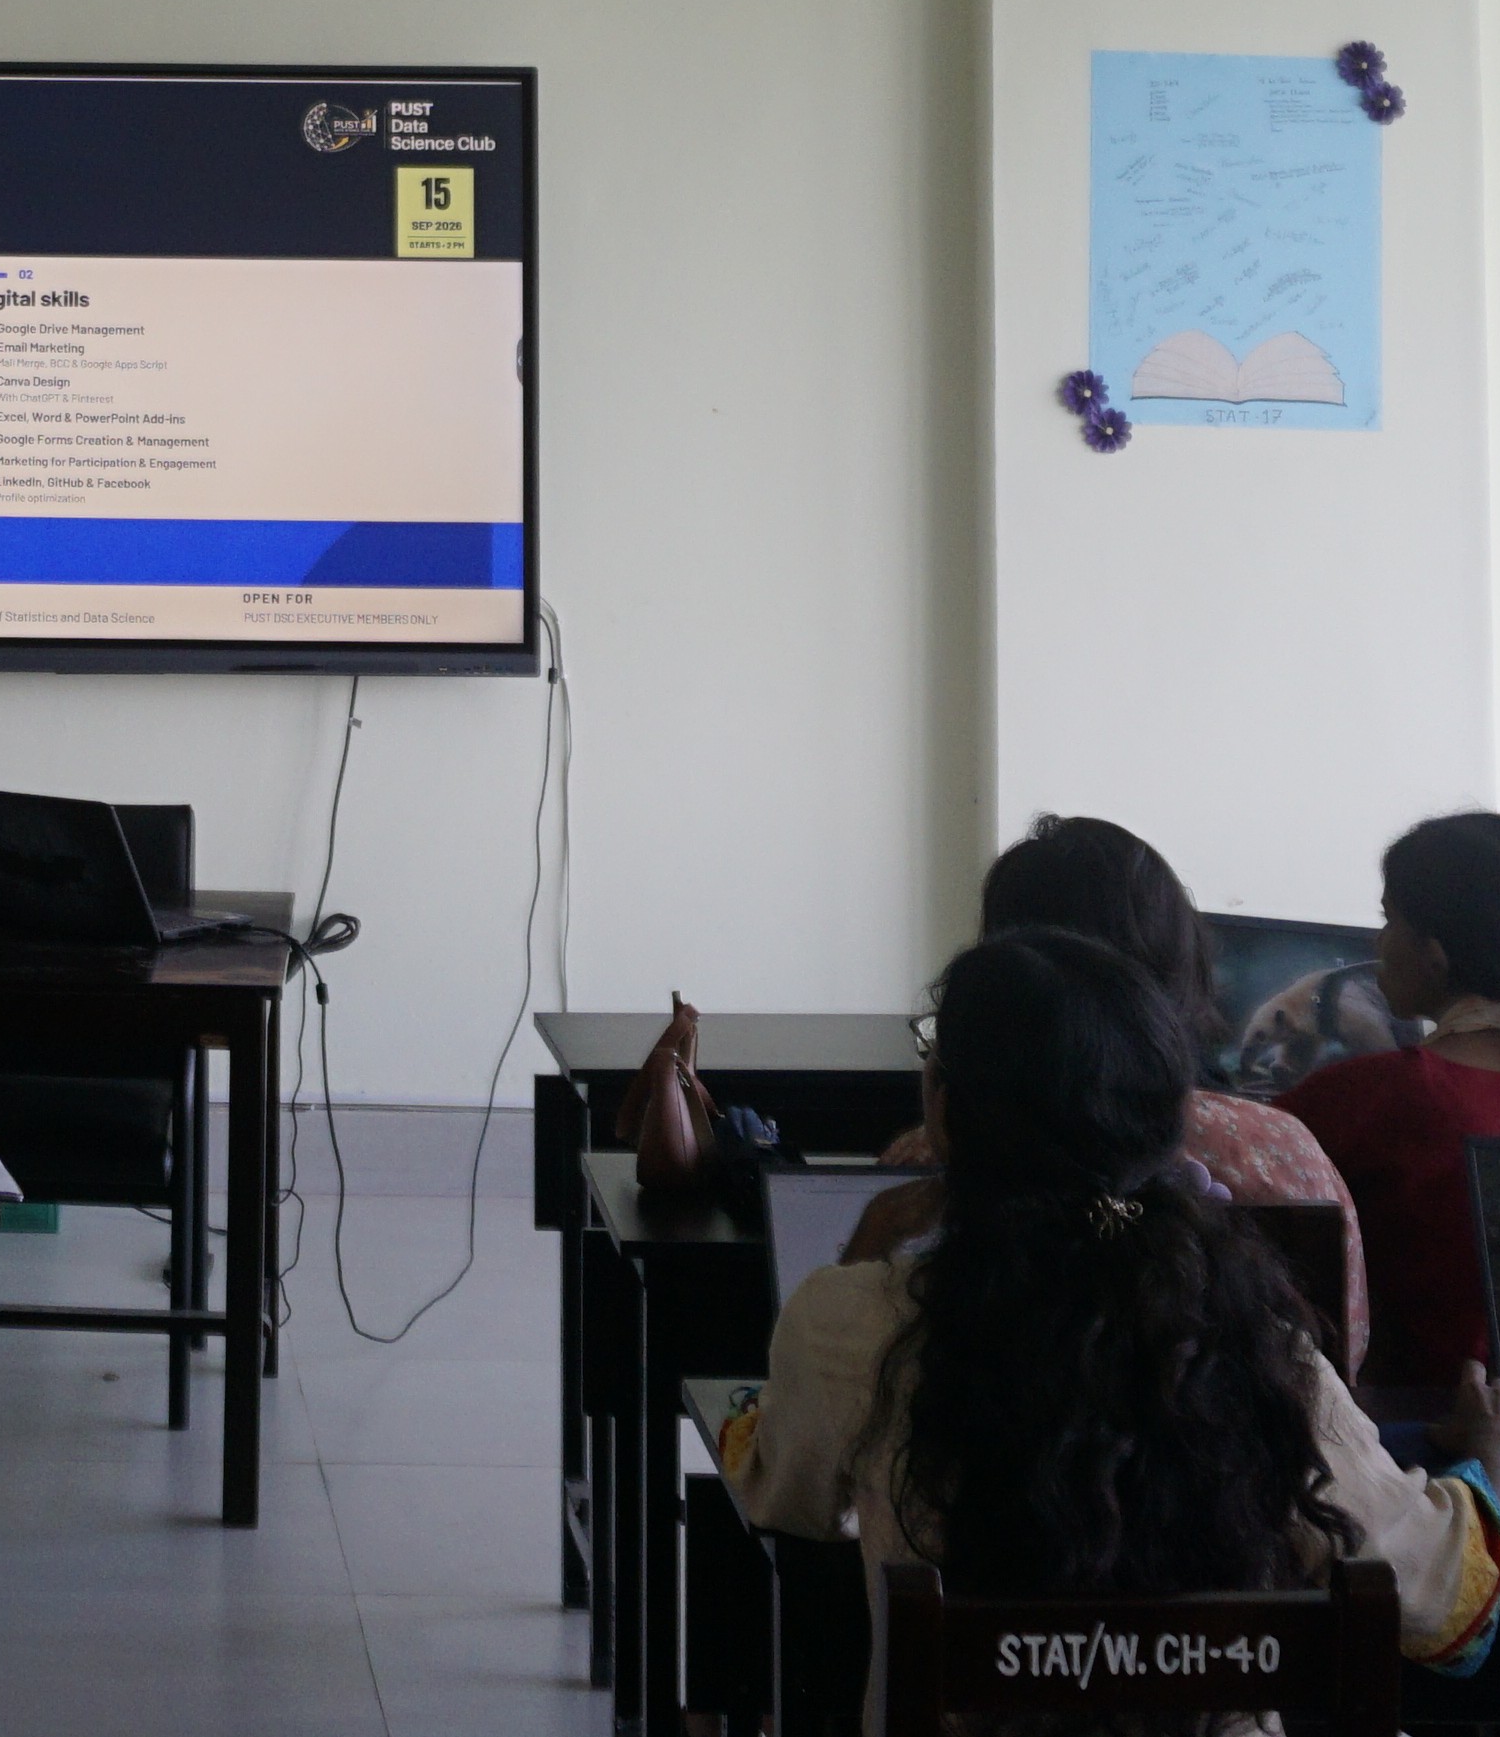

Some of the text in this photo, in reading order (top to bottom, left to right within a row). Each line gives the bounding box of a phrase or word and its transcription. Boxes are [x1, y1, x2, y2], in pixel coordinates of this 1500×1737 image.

[391, 102, 433, 116] PUST
[391, 119, 429, 134] Data
[391, 136, 496, 151] Science Club
[421, 177, 451, 210] 15
[411, 221, 462, 231] SEP 2026
[18, 269, 34, 280] 02
[40, 290, 90, 308] skills
[39, 324, 69, 336] Drive
[71, 324, 145, 338] Management
[30, 342, 85, 356] Marketing
[33, 376, 71, 390] Design
[32, 412, 62, 423] Word
[64, 413, 72, 424] &
[75, 413, 140, 425] PowerPoint
[142, 413, 186, 425] Add-ins
[37, 434, 73, 446] Forms
[75, 435, 124, 447] Creation
[126, 436, 134, 447] &
[137, 436, 210, 449] Management
[50, 456, 66, 468] for
[68, 456, 137, 471] Participation
[138, 458, 147, 469] &
[149, 458, 217, 472] Engagement
[47, 477, 84, 489] GitHub
[86, 478, 94, 489] &
[97, 478, 151, 490] Facebook
[27, 493, 86, 505] optimization
[243, 593, 313, 605] OPEN FOR
[4, 611, 58, 623] Statistics
[60, 612, 80, 624] and
[83, 612, 109, 624] Data
[110, 612, 155, 624] Science
[244, 612, 271, 624] PUST
[296, 613, 355, 625] EXECUTIVE
